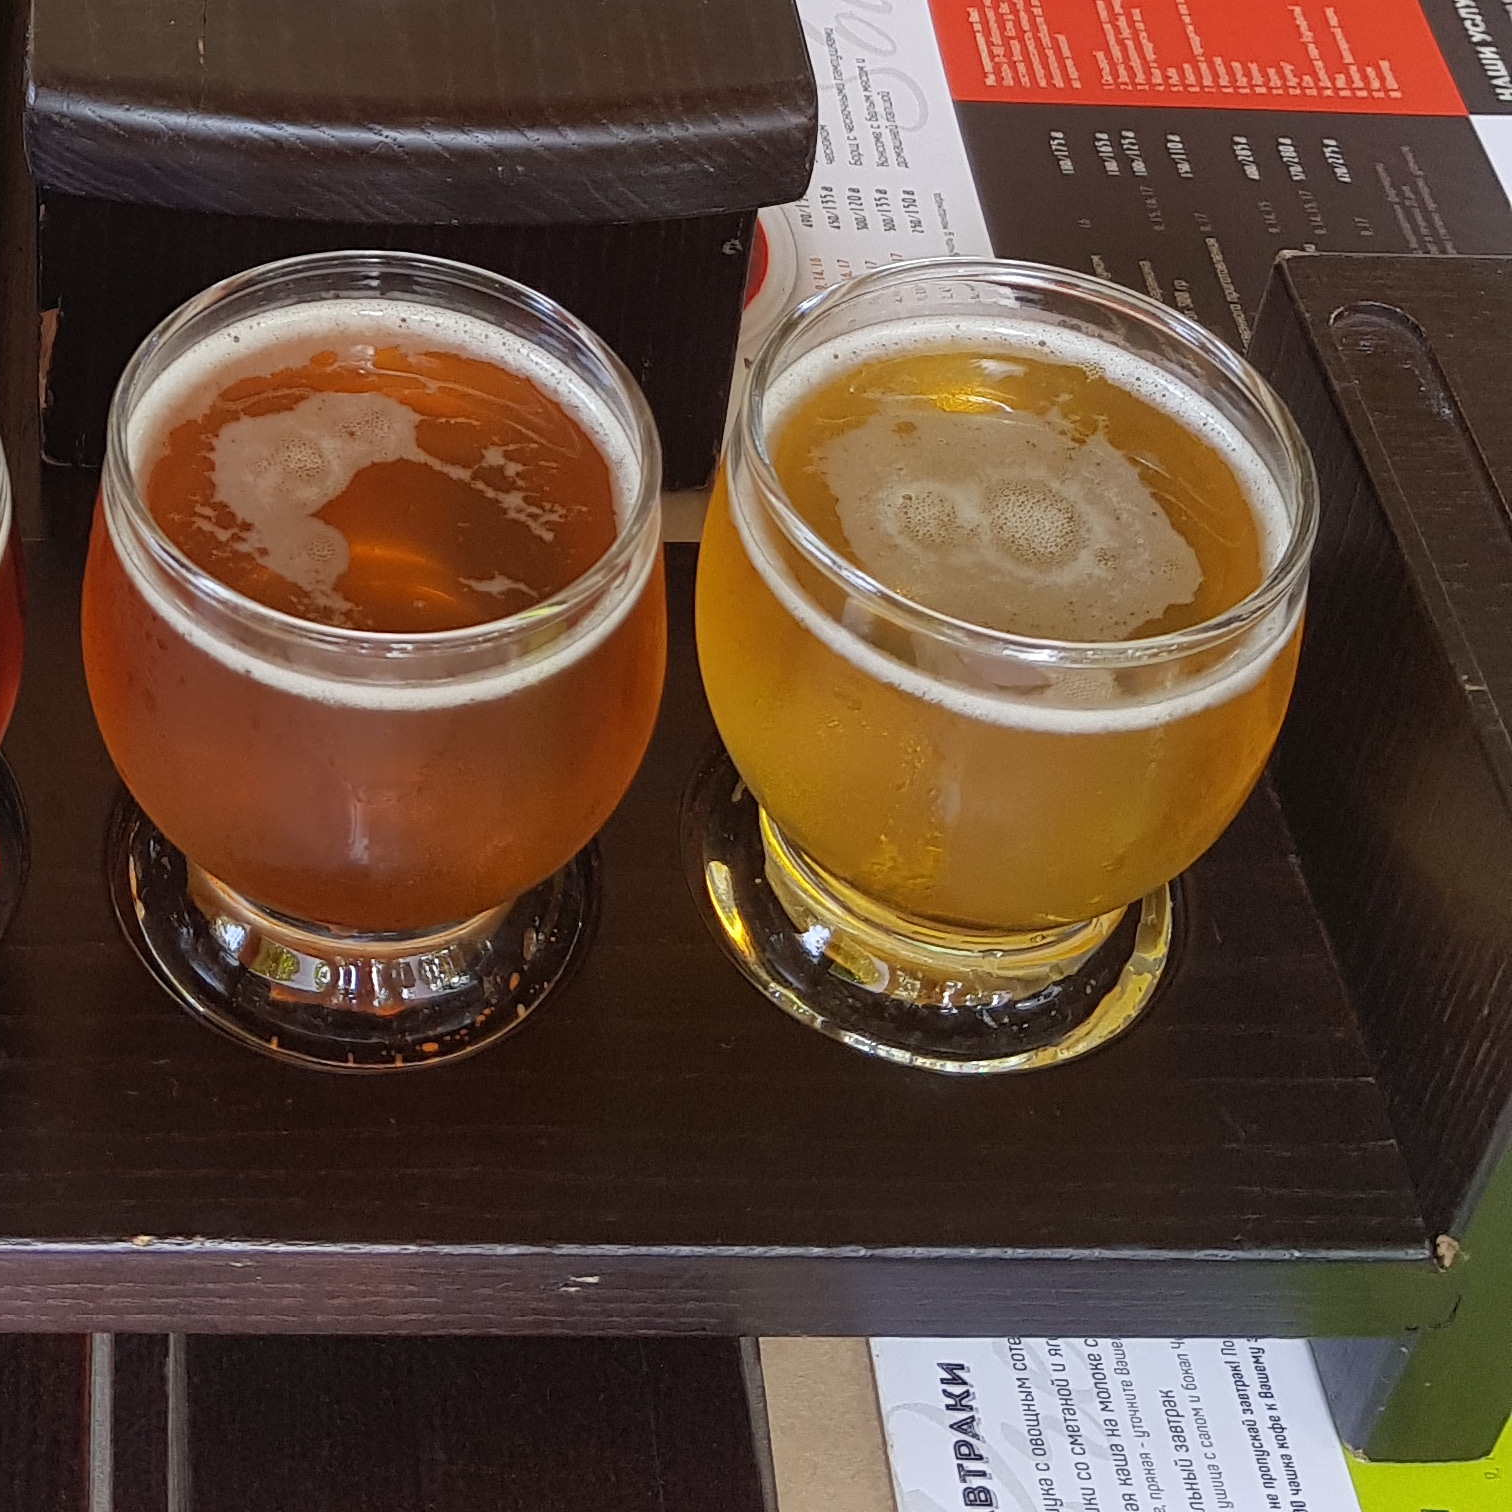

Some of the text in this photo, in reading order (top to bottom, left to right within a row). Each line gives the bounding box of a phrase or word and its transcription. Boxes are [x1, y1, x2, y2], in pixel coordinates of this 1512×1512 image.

[823, 27, 844, 81] пампушками
[1476, 46, 1512, 101] НАШИ
[834, 83, 855, 134] чесночными
[818, 125, 836, 165] чесноком
[872, 131, 890, 168] Консоме
[877, 90, 909, 169] домашней лапшой
[848, 143, 863, 166] Борщ
[1083, 1338, 1098, 1348] с
[1111, 1337, 1130, 1375] Ваше
[1051, 1363, 1066, 1372] и
[1087, 1353, 1115, 1413] молоке
[1176, 1353, 1198, 1391] бокал
[1223, 1361, 1251, 1415] завтрак!
[1248, 1346, 1274, 1399] Вашему
[1015, 1377, 1047, 1457] овощным
[1050, 1378, 1085, 1456] сметаной
[1121, 1380, 1150, 1438] уточните
[1188, 1395, 1201, 1403] и
[1265, 1403, 1278, 1411] к
[936, 1362, 997, 1512] ВТРАКИ
[1103, 1419, 1121, 1437] на
[1158, 1389, 1189, 1453] завтрак
[1191, 1408, 1213, 1448] салом
[1267, 1415, 1290, 1449] кофе
[1035, 1462, 1050, 1472] с
[1074, 1462, 1092, 1481] со
[1109, 1444, 1133, 1486] каша
[1204, 1452, 1216, 1460] с
[1241, 1419, 1277, 1489] пропускай
[1139, 1453, 1164, 1500] пряная
[1280, 1454, 1302, 1496] чашка
[1266, 1494, 1282, 1509] не
